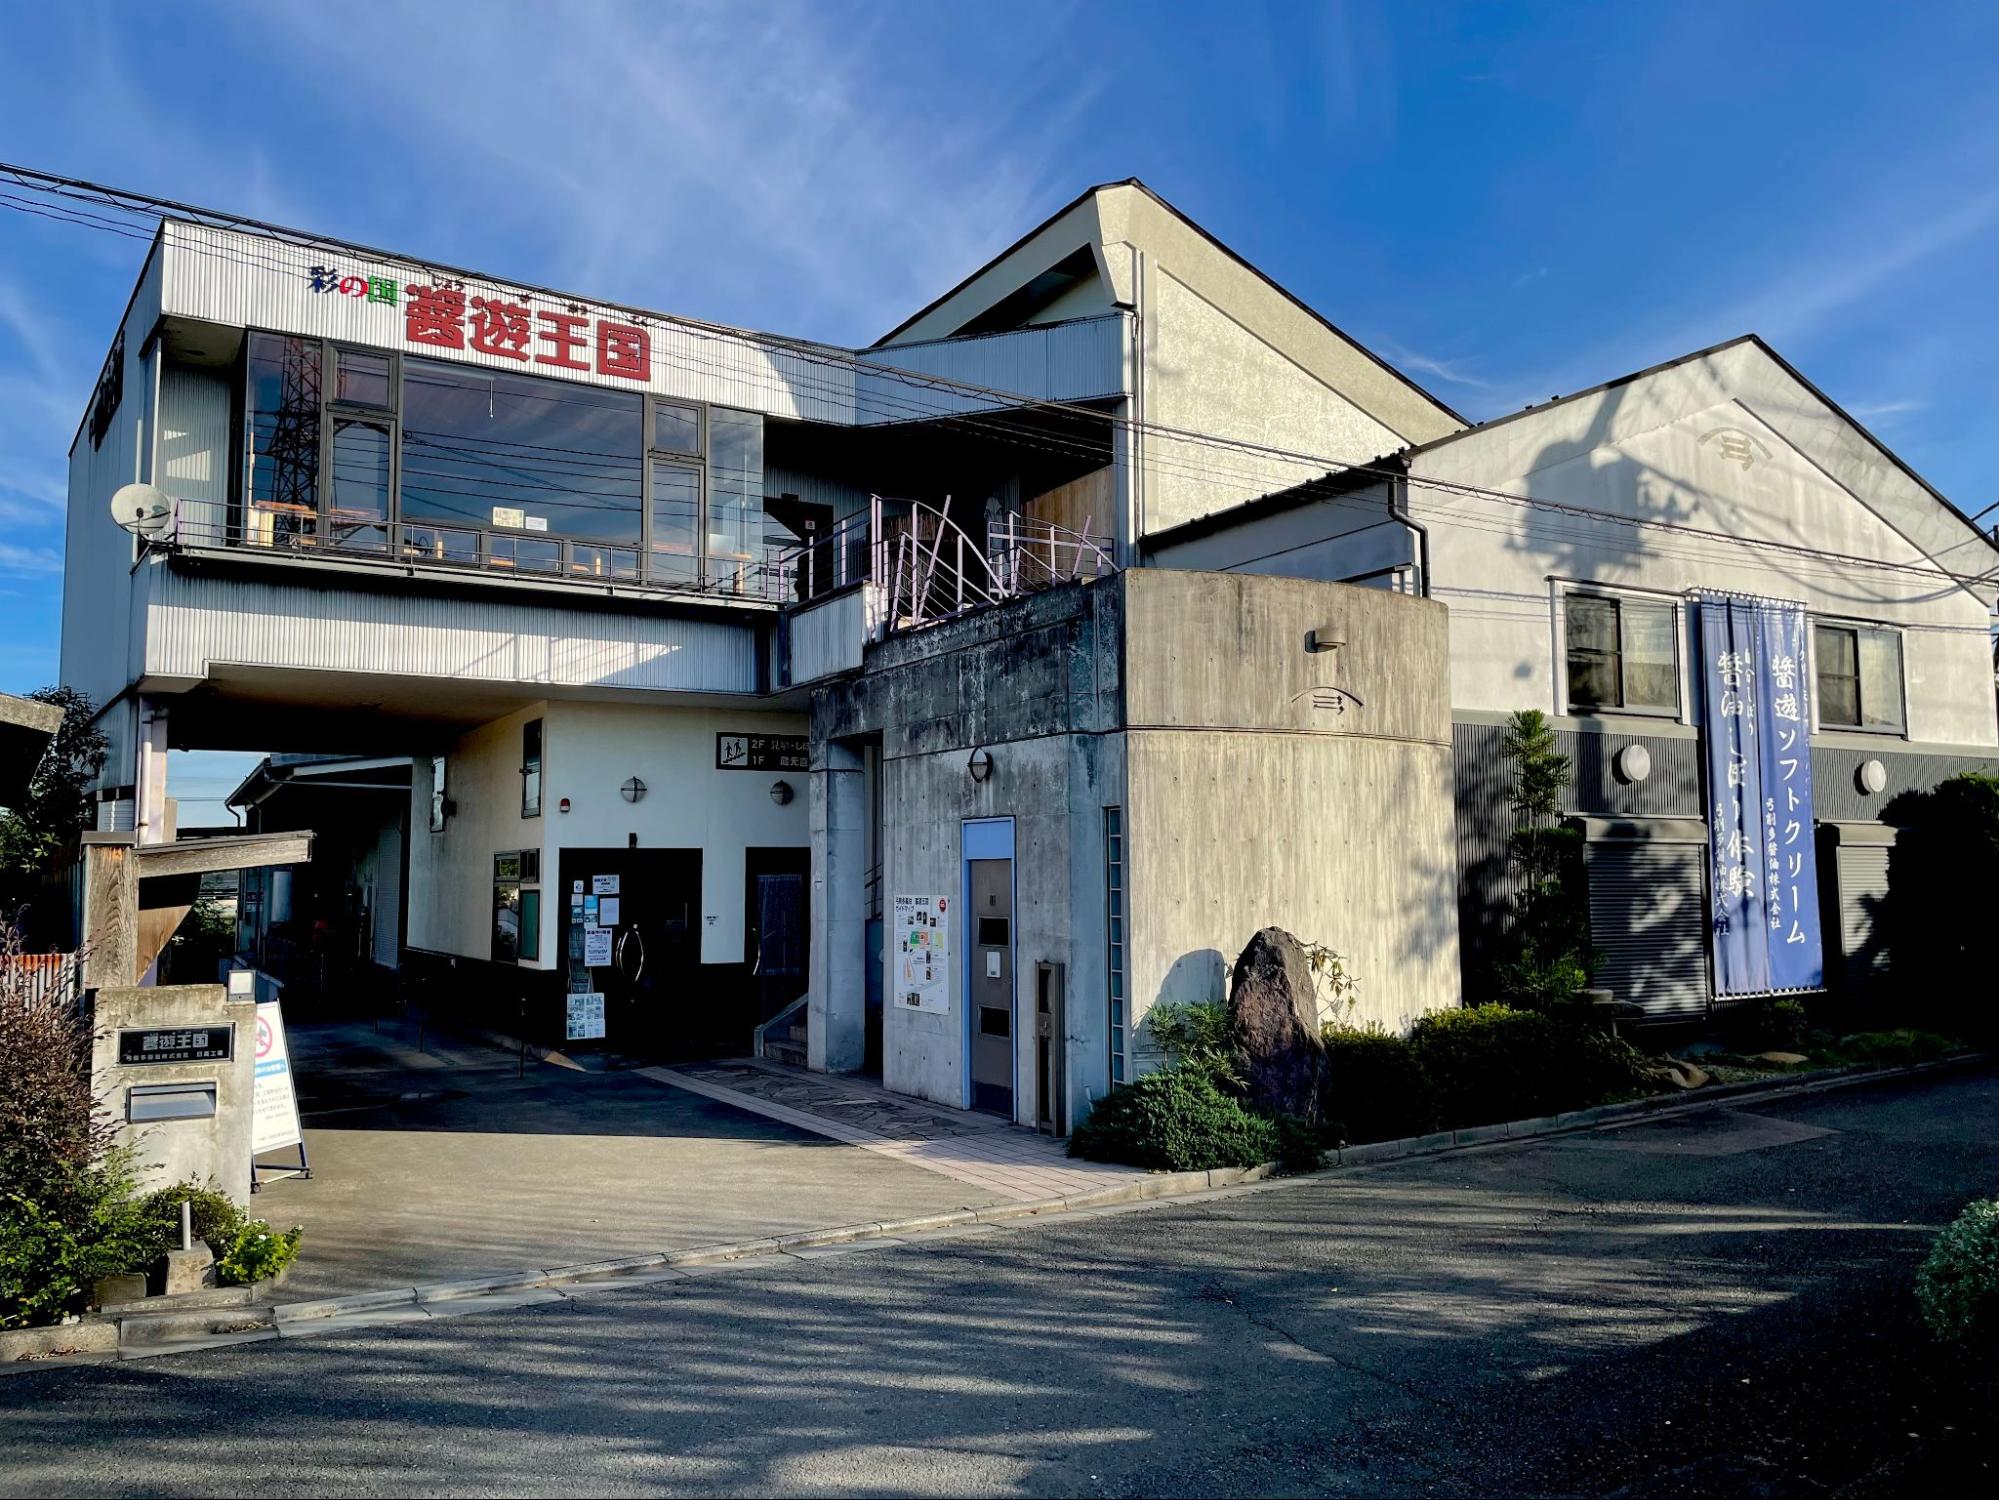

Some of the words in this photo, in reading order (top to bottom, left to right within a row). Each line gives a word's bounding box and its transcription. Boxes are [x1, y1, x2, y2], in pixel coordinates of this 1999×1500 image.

[306, 264, 398, 307] 彩の国
[751, 739, 766, 749] 2F
